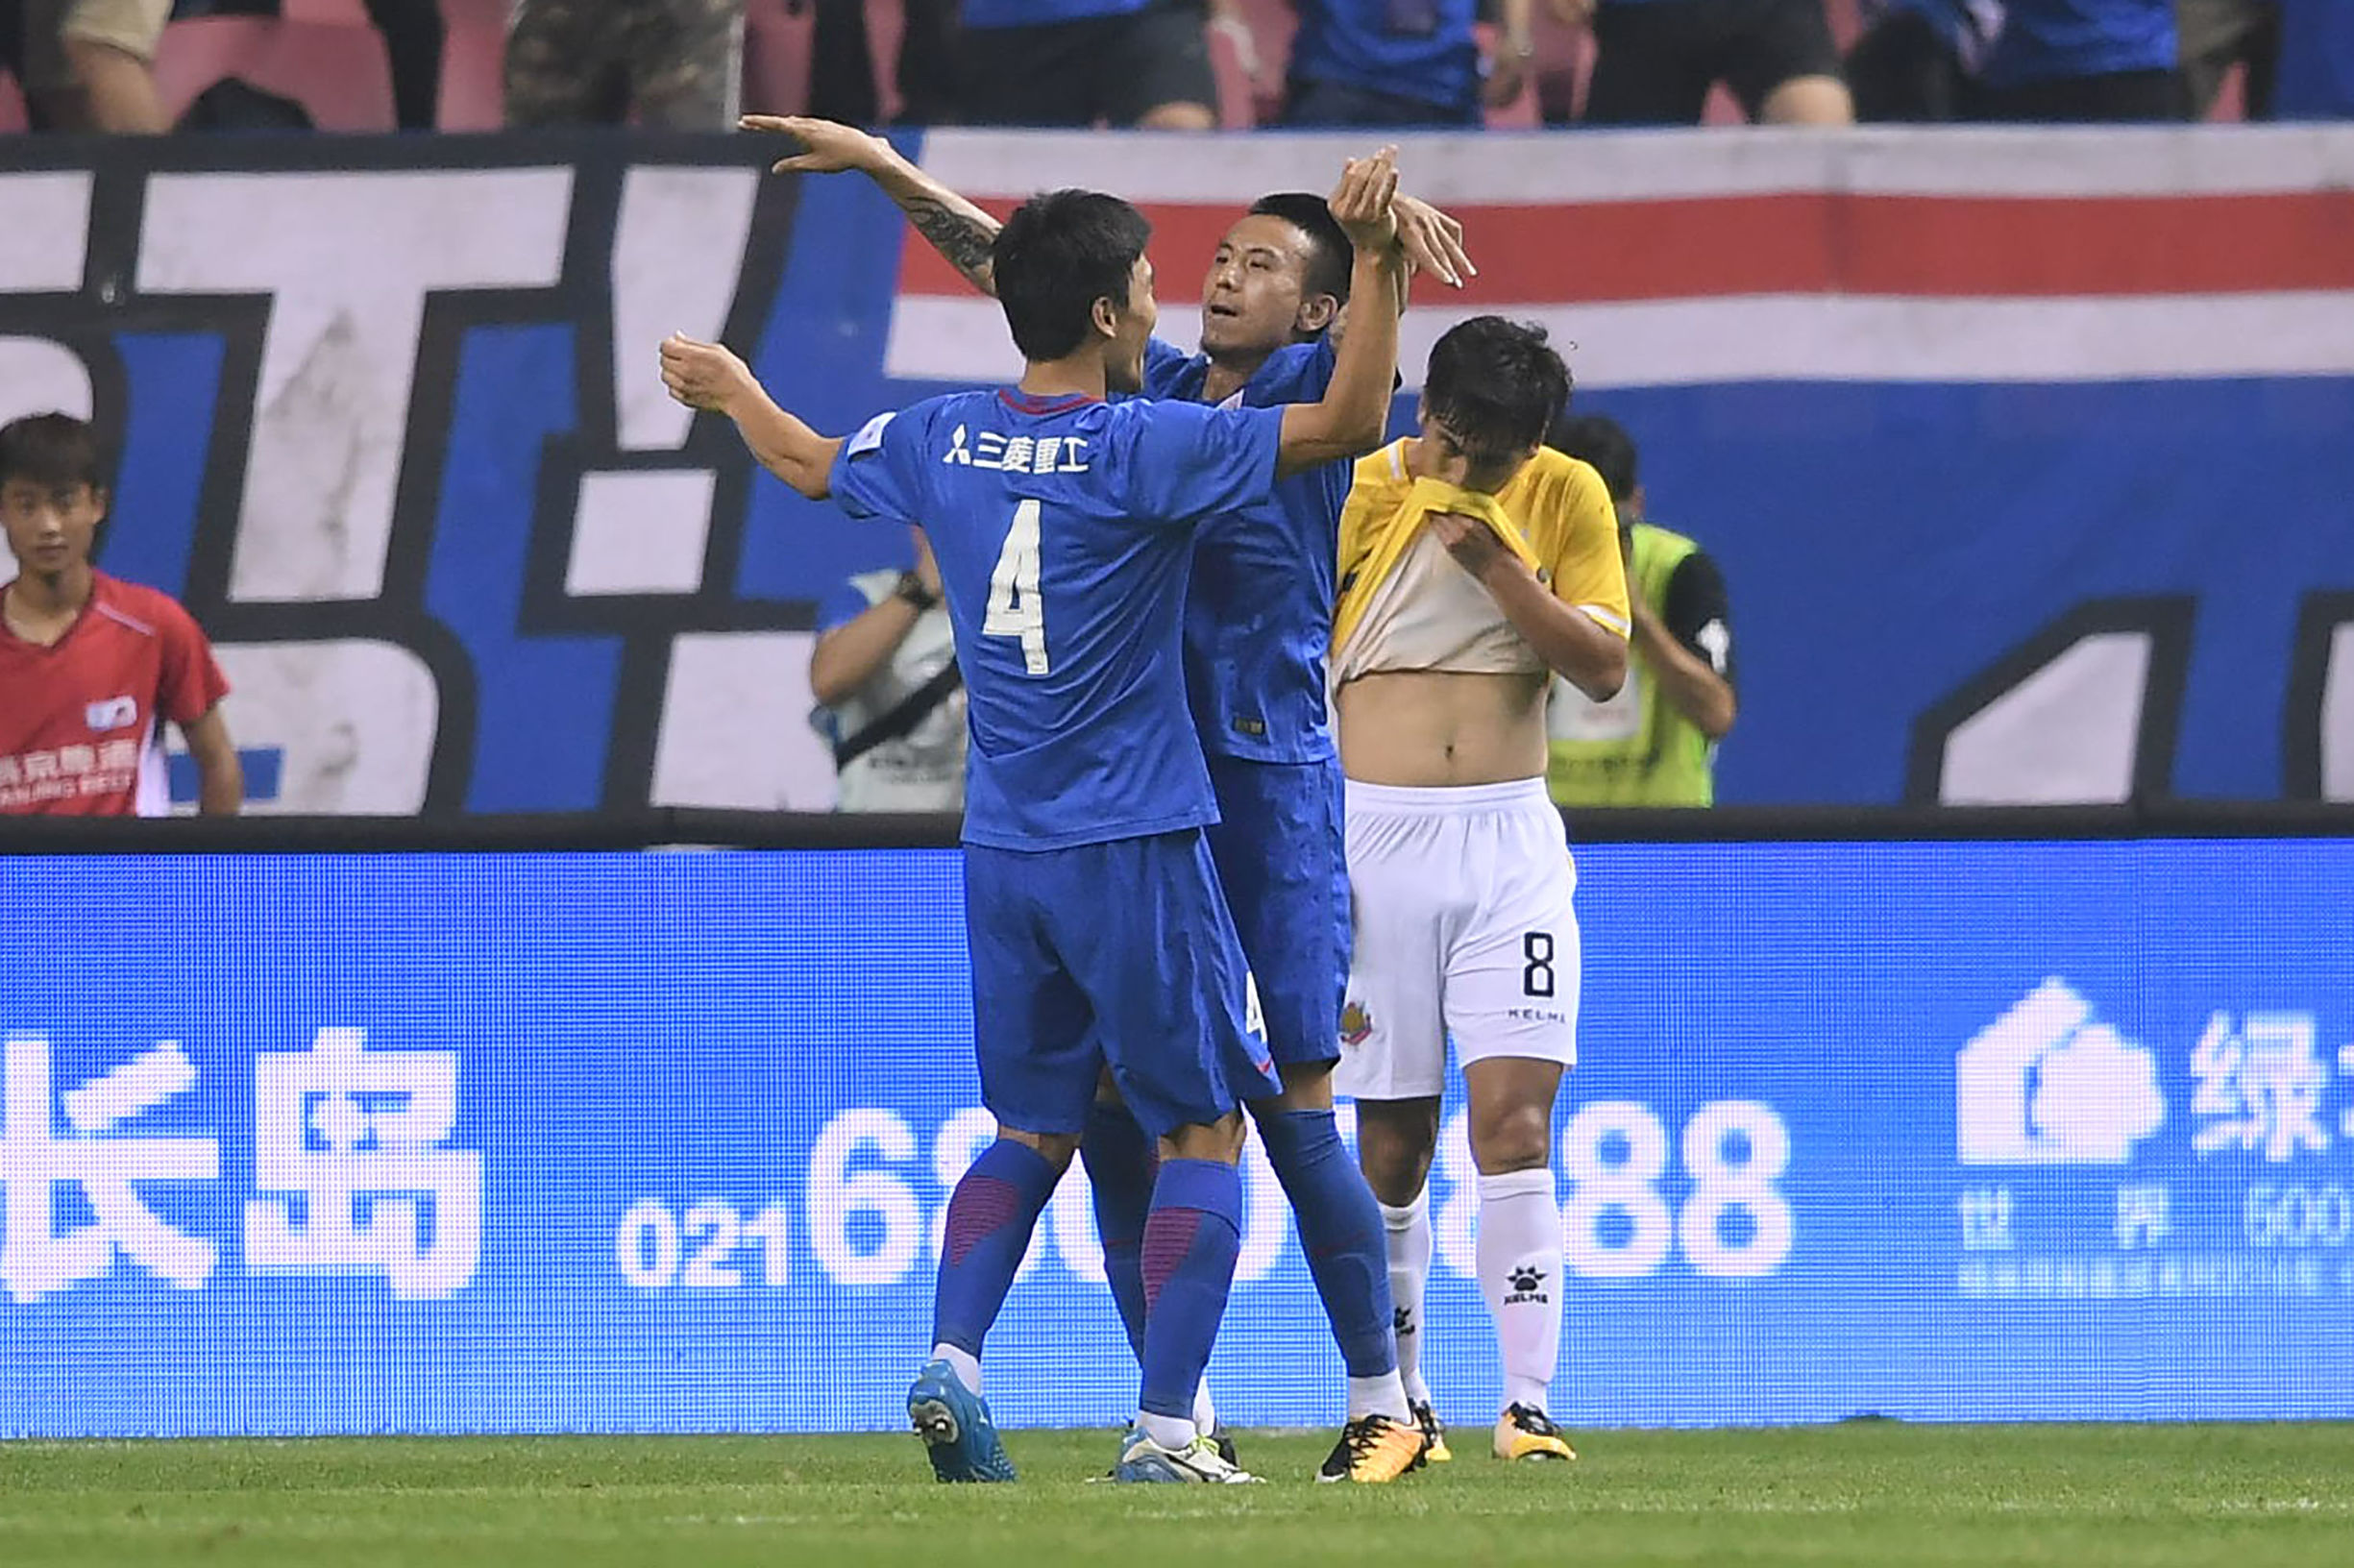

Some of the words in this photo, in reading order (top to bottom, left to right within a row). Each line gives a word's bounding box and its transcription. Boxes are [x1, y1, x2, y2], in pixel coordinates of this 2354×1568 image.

[972, 431, 1089, 474] 三菱重工
[982, 500, 1048, 674] 4
[1524, 931, 1555, 997] 8
[2191, 1009, 2354, 1164] 绿
[0, 1026, 485, 1301] 长岛
[617, 1197, 790, 1287] 021
